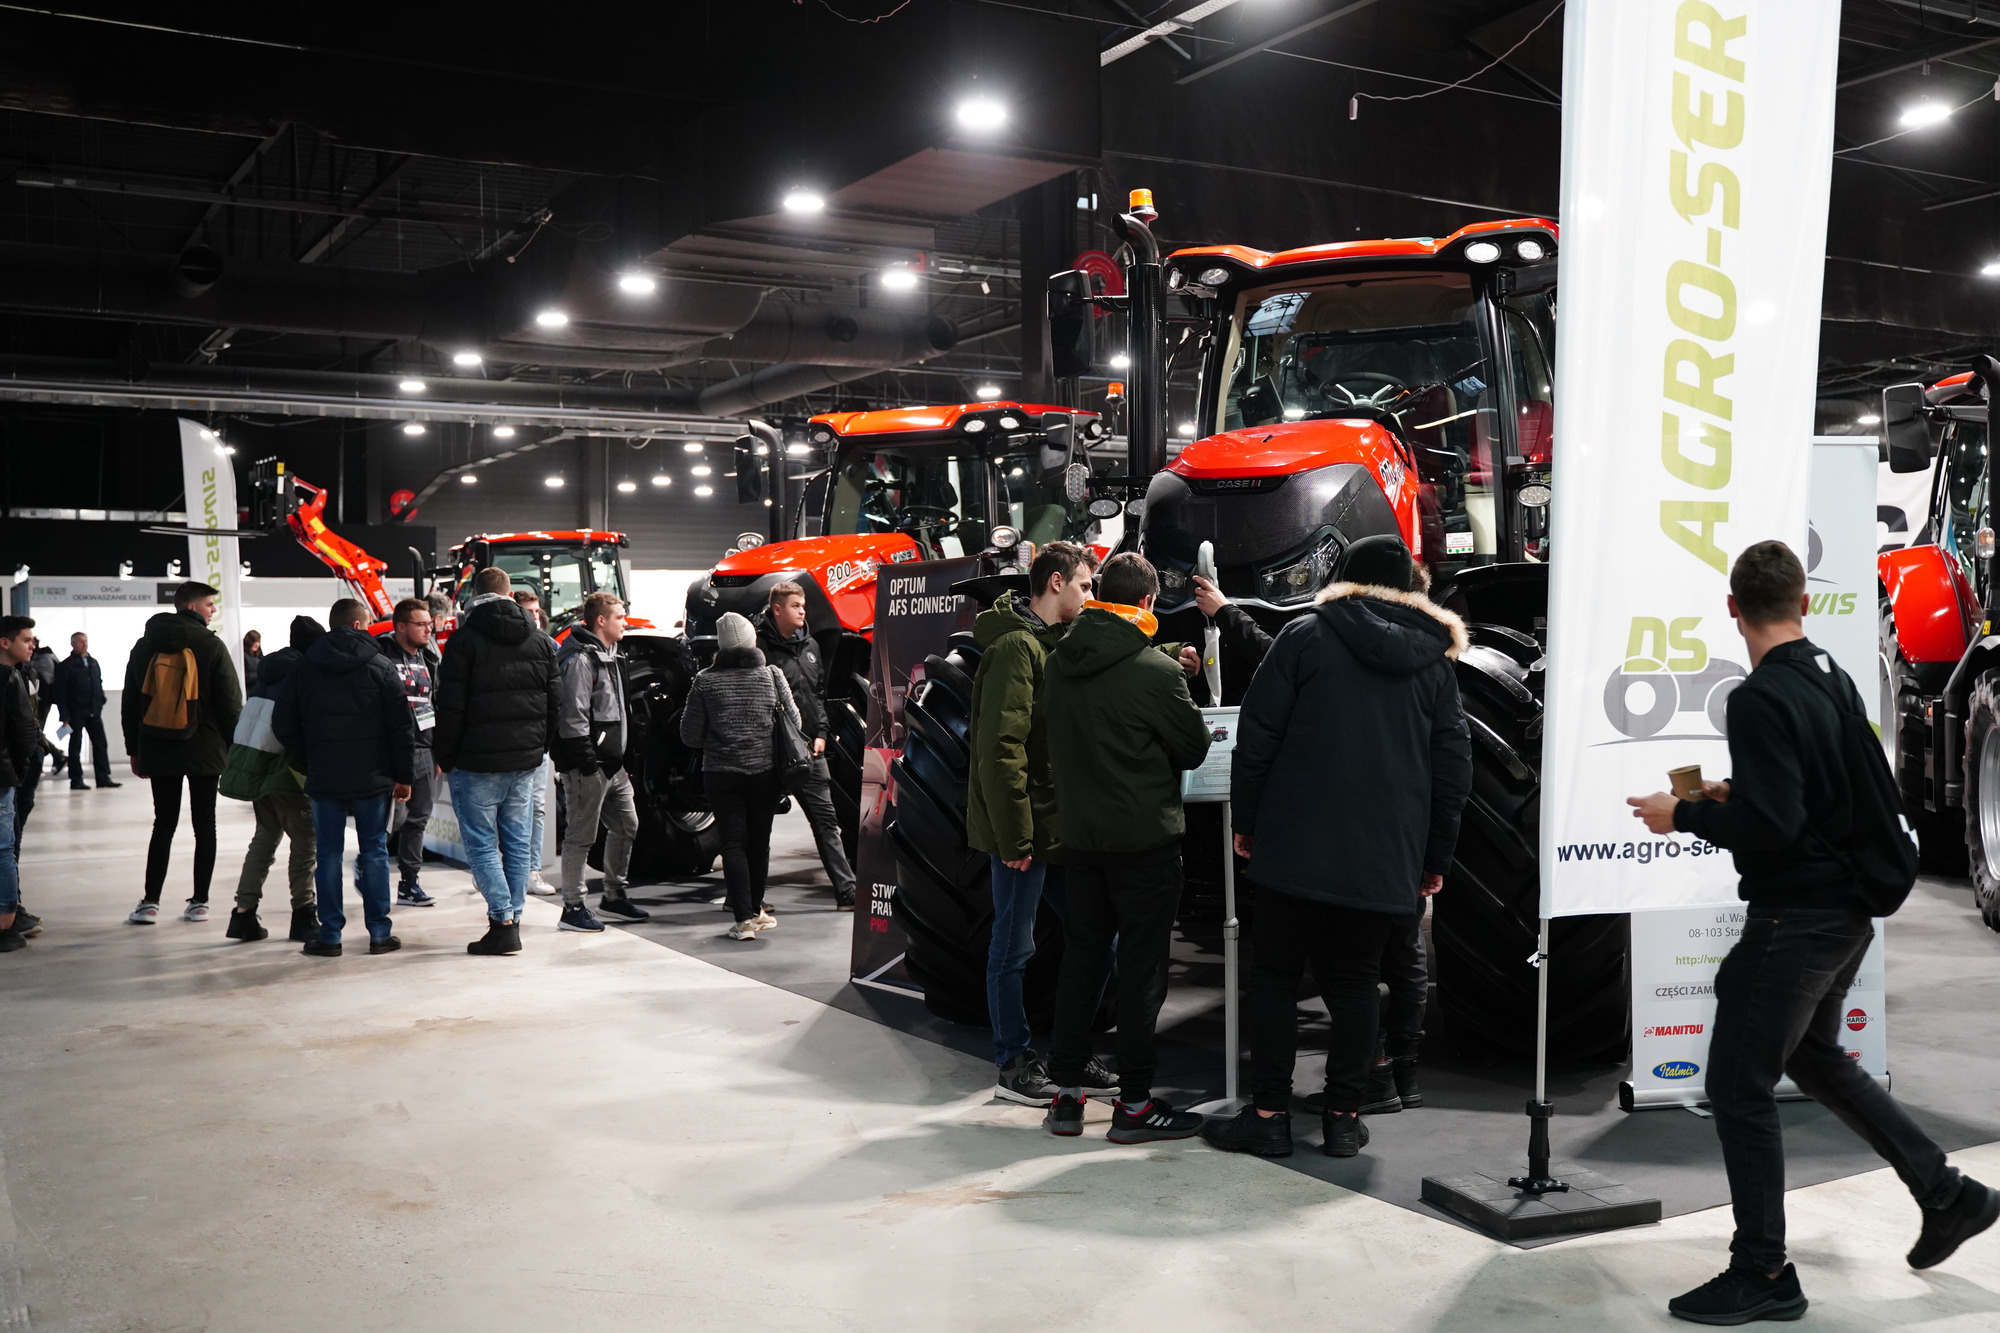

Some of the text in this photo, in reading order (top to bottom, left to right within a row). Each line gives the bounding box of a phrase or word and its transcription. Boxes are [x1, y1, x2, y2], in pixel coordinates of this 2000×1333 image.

[1217, 480, 1250, 488] CASE
[827, 560, 851, 583] 200
[890, 576, 926, 596] OPTUM
[888, 598, 908, 616] AFS
[1623, 616, 1708, 672] DS
[870, 917, 888, 933] PRO
[1716, 914, 1728, 923] ul.
[1688, 928, 1722, 938] 08-103
[1655, 985, 1688, 998] CZĘŚCI
[1655, 1024, 1704, 1036] MANITOU
[1660, 1063, 1695, 1077] Italmix
